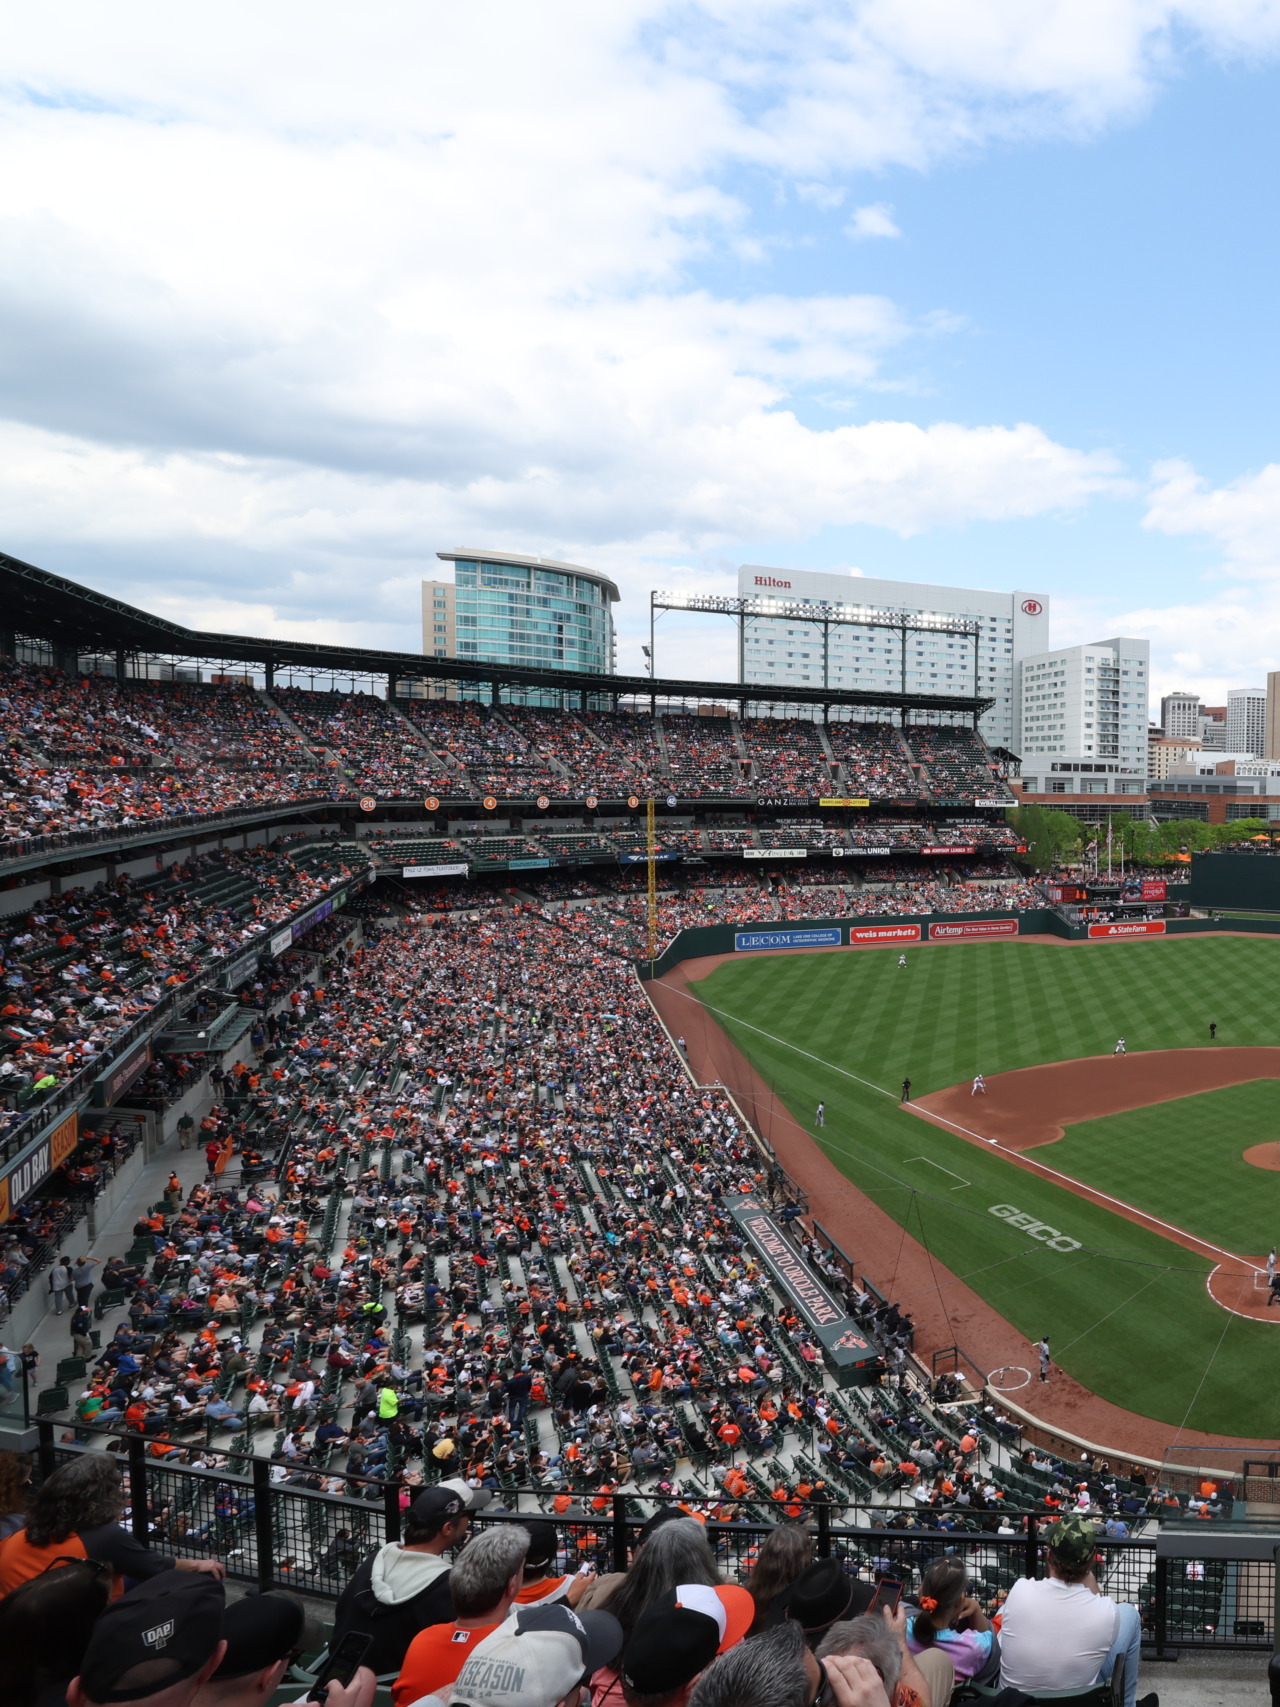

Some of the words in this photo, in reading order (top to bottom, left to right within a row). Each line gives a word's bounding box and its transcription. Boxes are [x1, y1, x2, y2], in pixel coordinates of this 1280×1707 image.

[754, 576, 791, 588] Hilton
[758, 798, 788, 806] GANZ
[878, 928, 916, 937] markets
[935, 925, 963, 935] Airtemp
[11, 1162, 31, 1205] OLD
[32, 1142, 49, 1185] BAY
[748, 1217, 787, 1256] WELCOME
[988, 1204, 1082, 1252] GEICO
[774, 1253, 796, 1267] TO
[782, 1265, 820, 1298] ORIOLE
[805, 1295, 839, 1324] PARK
[147, 1623, 171, 1643] DAP
